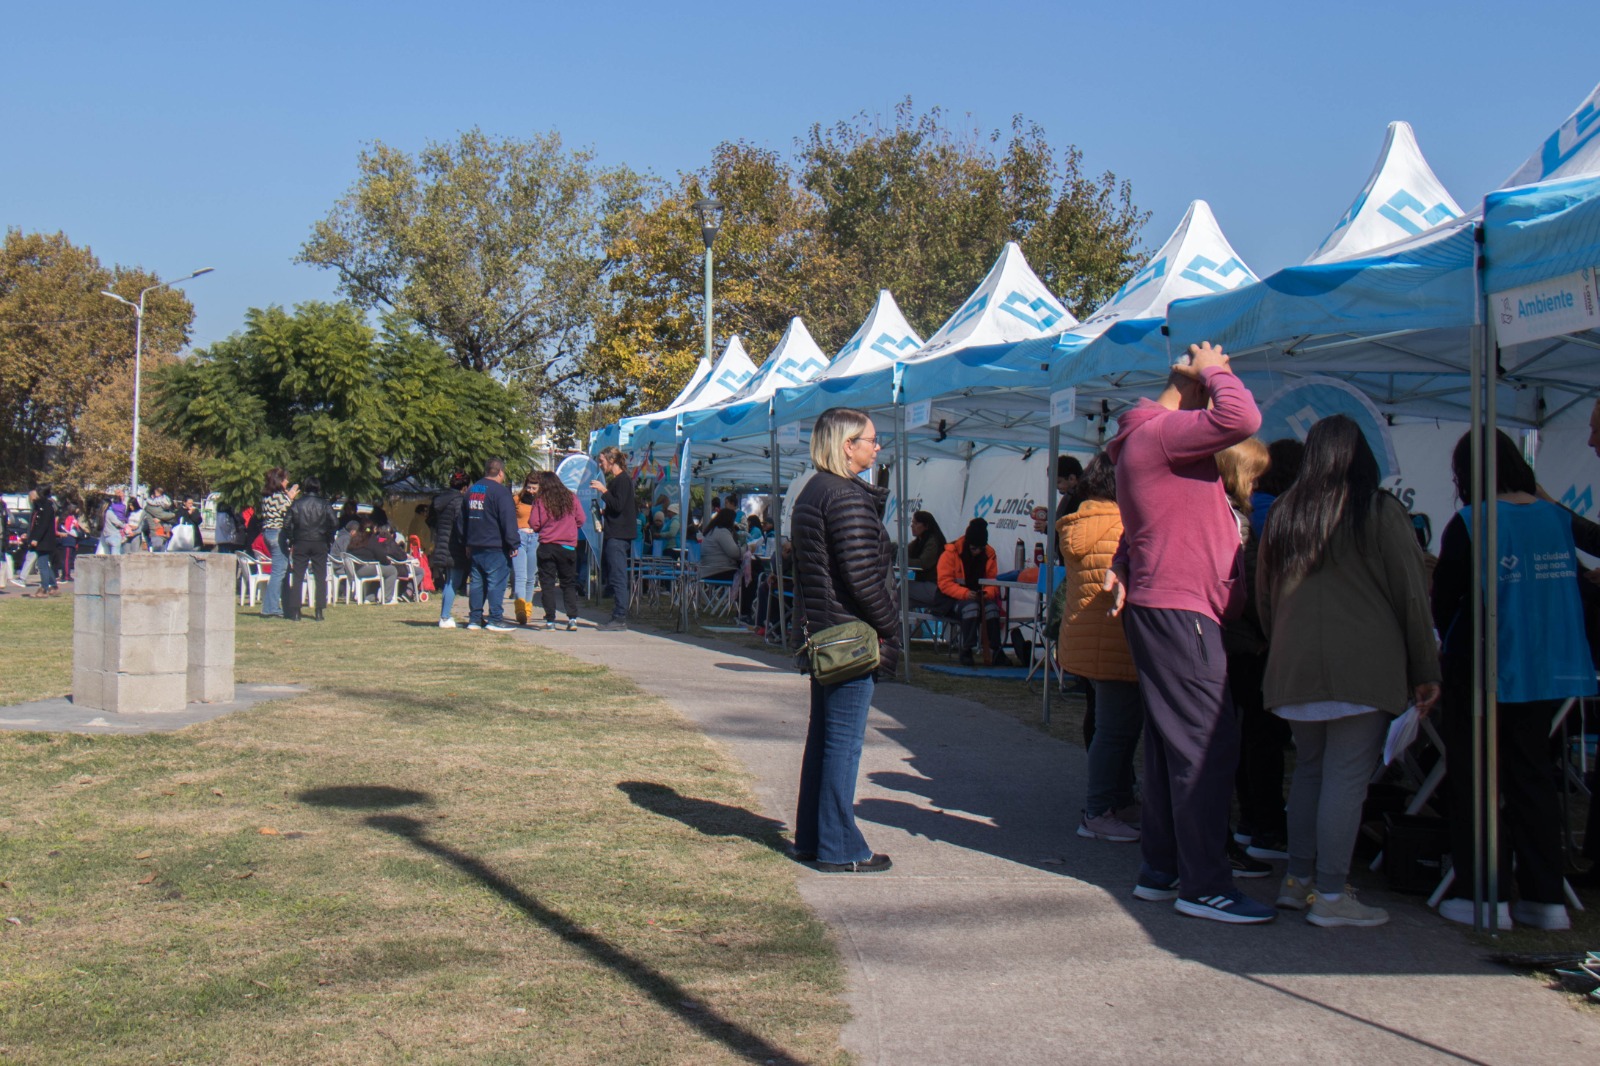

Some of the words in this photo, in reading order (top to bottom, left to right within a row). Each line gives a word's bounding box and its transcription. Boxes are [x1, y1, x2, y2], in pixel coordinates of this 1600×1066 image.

[1518, 290, 1574, 318] Ambiente
[993, 493, 1035, 515] Lanús
[1533, 553, 1541, 561] la
[1542, 551, 1570, 561] ciudad
[1534, 563, 1548, 572] que
